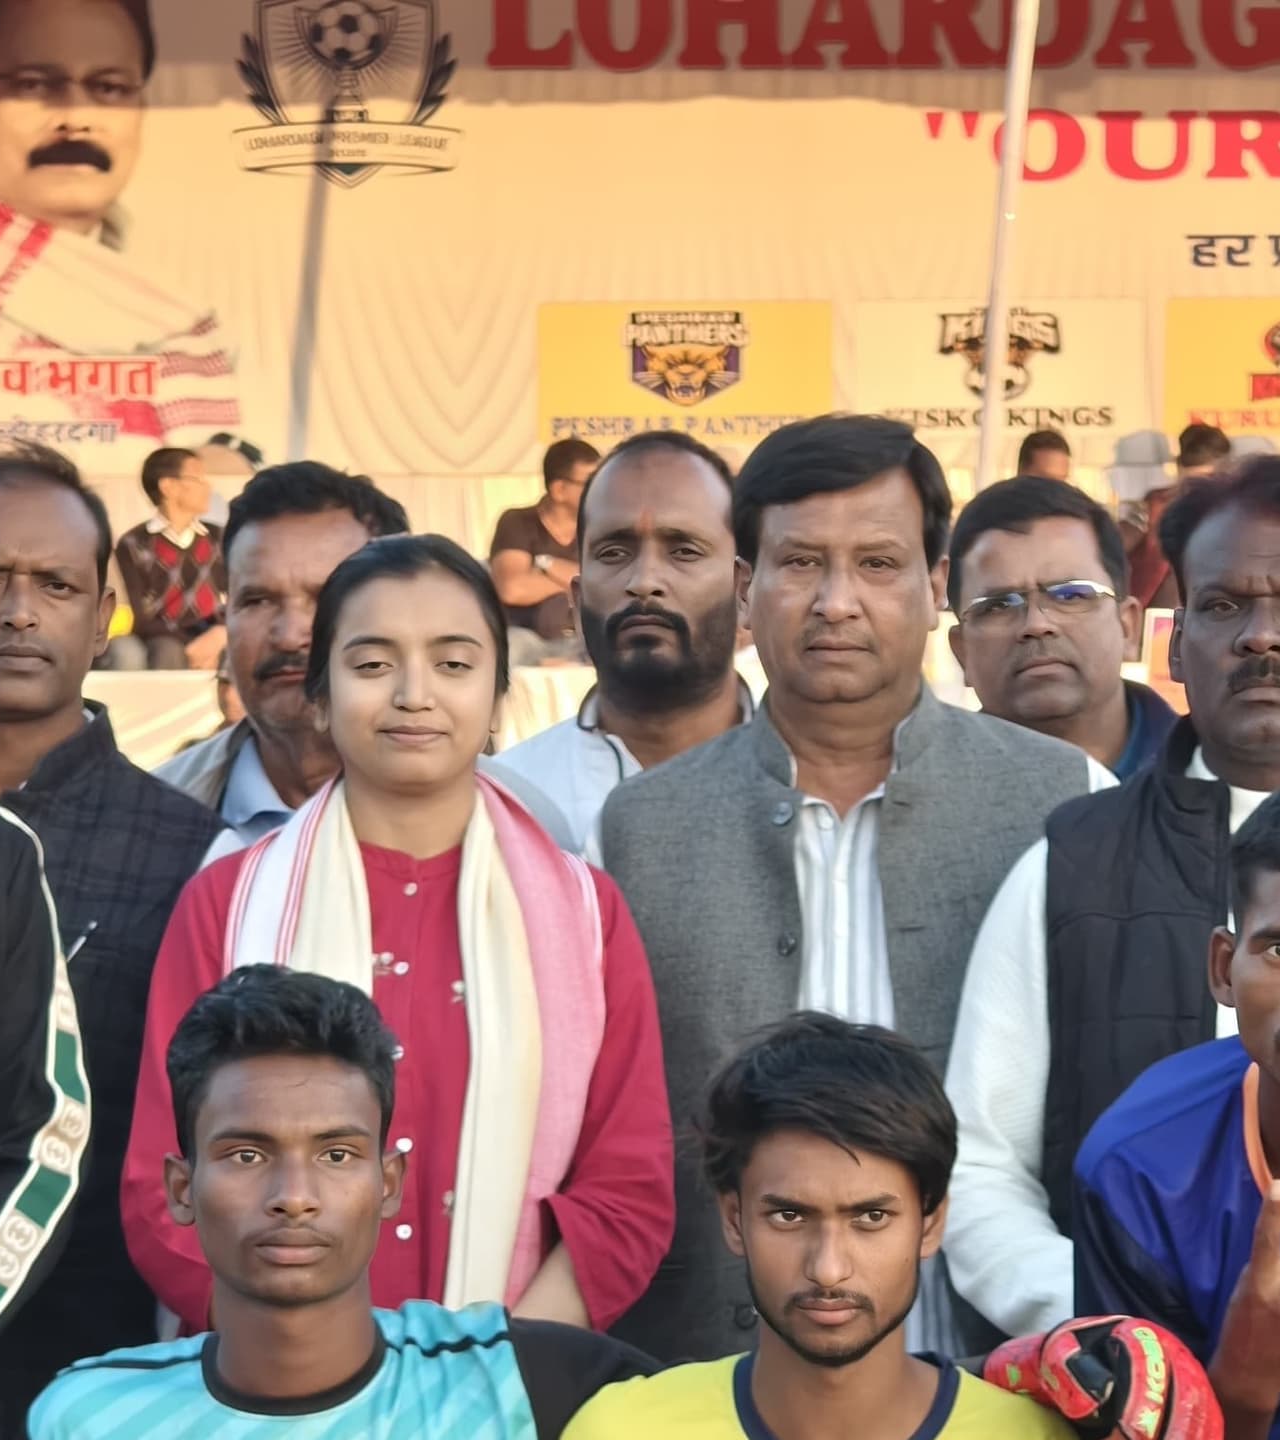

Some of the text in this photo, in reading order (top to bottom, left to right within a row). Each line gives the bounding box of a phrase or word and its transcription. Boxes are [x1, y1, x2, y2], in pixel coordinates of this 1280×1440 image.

[1186, 233, 1257, 268] हर
[43, 357, 162, 396] भगत
[1005, 406, 1115, 428] KINGS
